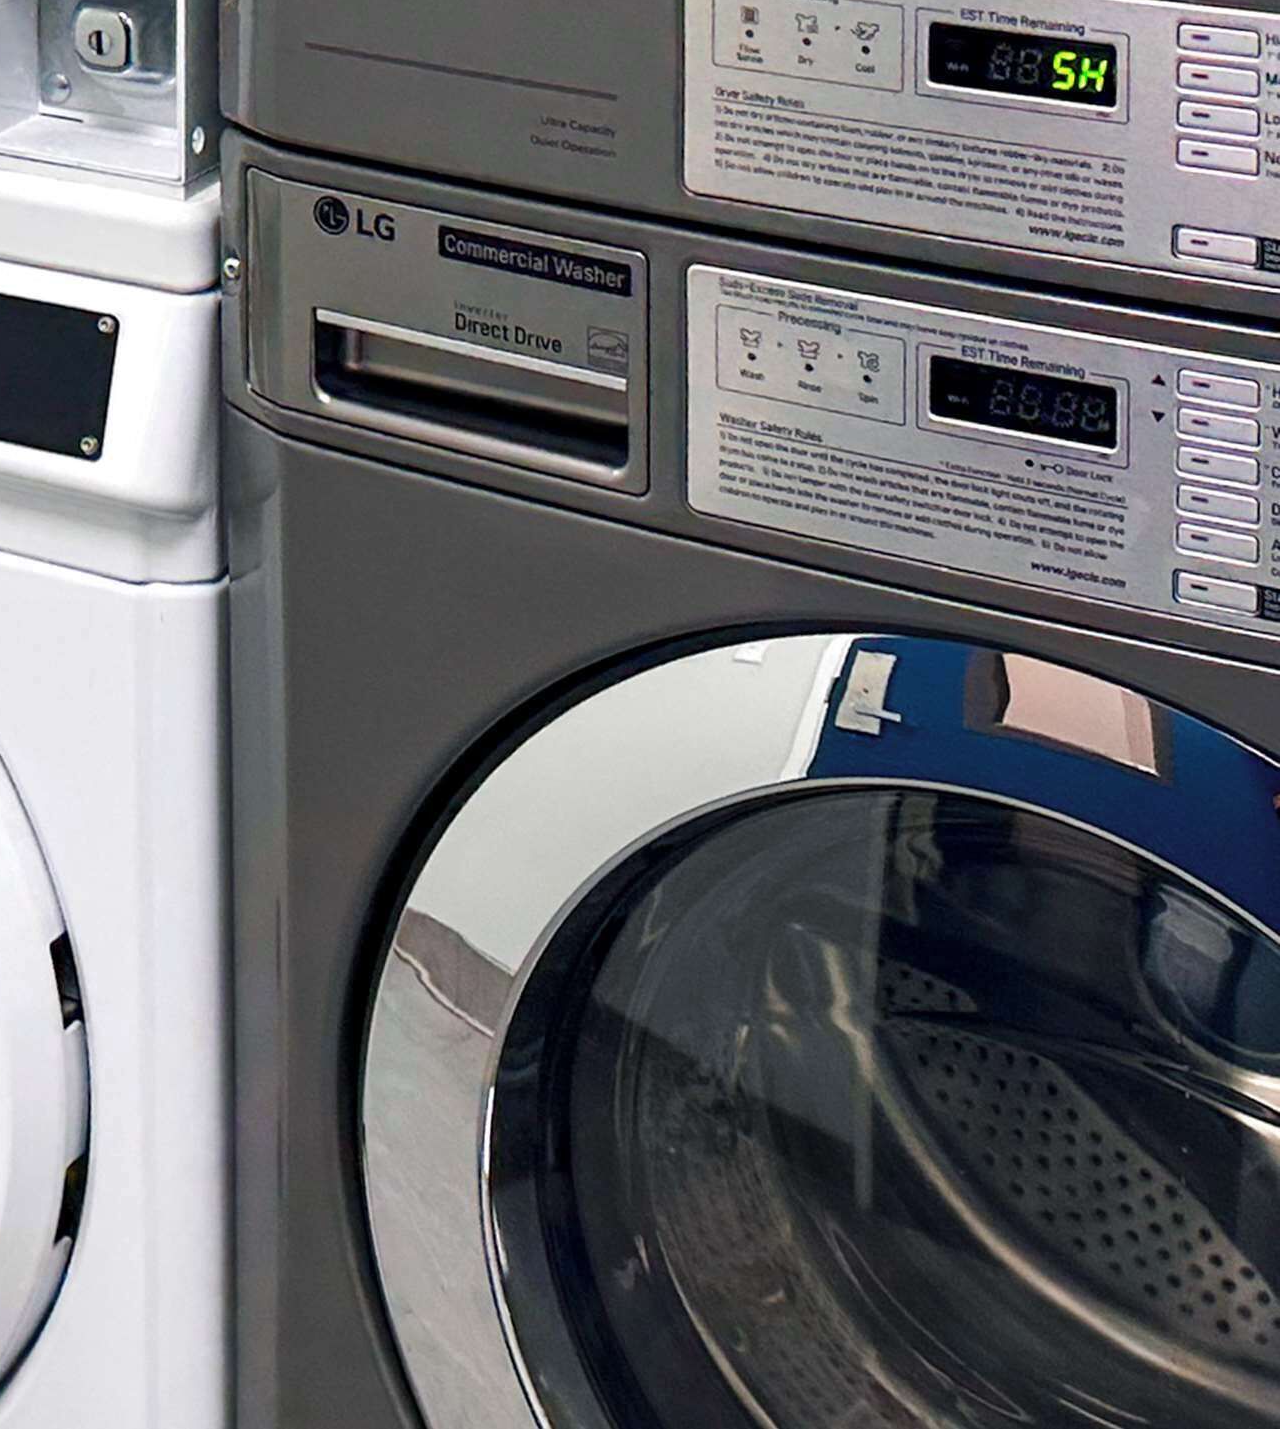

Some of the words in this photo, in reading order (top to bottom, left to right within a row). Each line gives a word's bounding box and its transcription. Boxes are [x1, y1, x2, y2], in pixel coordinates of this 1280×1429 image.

[961, 8, 984, 21] EST
[989, 12, 1018, 27] Time
[1021, 16, 1085, 36] Remaining
[569, 120, 615, 139] Capacity
[562, 140, 616, 157] Operation
[355, 209, 395, 241] LG
[444, 234, 548, 273] Commercial
[552, 256, 624, 289] Washer
[455, 312, 510, 341] Direct
[514, 325, 563, 353] Drive
[777, 310, 843, 335] Processing
[961, 345, 985, 360] EST
[990, 349, 1018, 366] Time
[1021, 355, 1086, 379] Remaining
